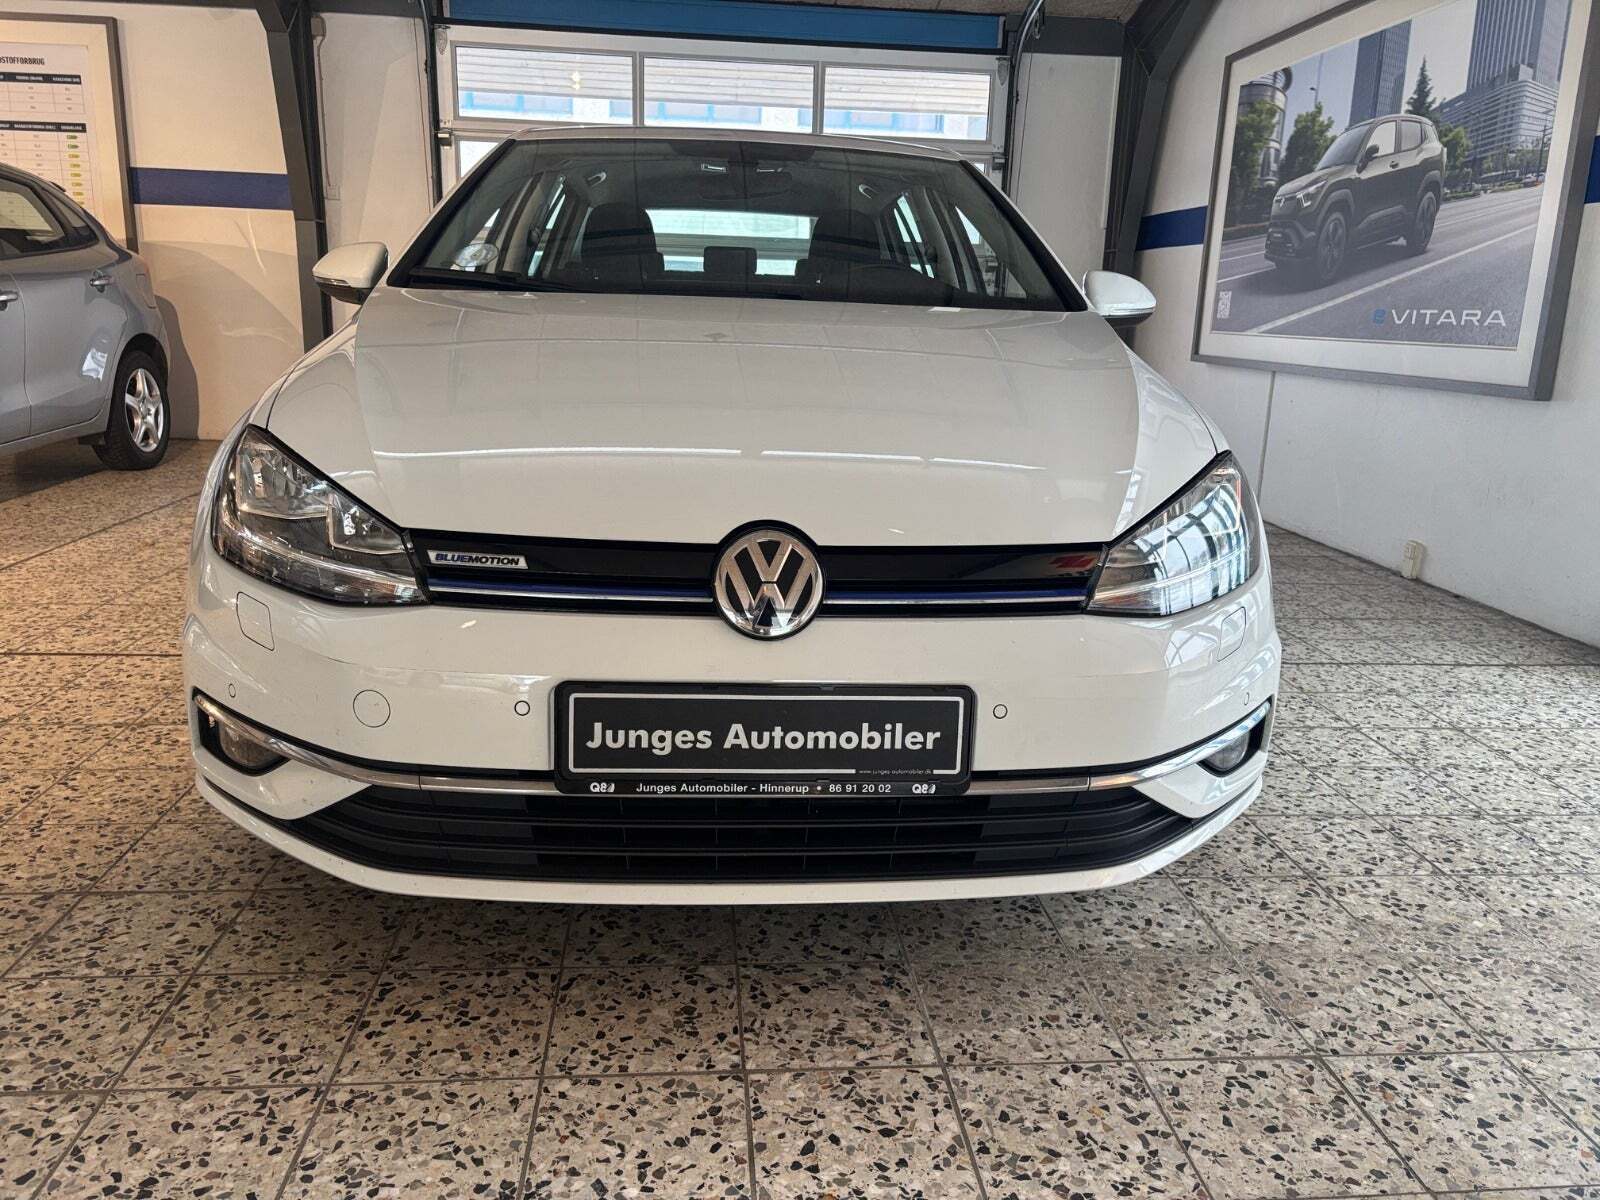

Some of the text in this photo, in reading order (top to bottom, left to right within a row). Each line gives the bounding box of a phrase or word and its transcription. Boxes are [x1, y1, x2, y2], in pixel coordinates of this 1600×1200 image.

[1391, 309, 1507, 327] VITARA
[433, 552, 520, 567] BLUEMOTION
[585, 722, 941, 756] Junges Automobiler
[636, 783, 677, 794] Junges
[680, 783, 748, 793] Automobiler
[759, 783, 809, 795] Hinnerup
[829, 784, 842, 793] 86
[845, 784, 857, 793] 91
[861, 784, 875, 793] 20
[878, 784, 892, 793] 02
